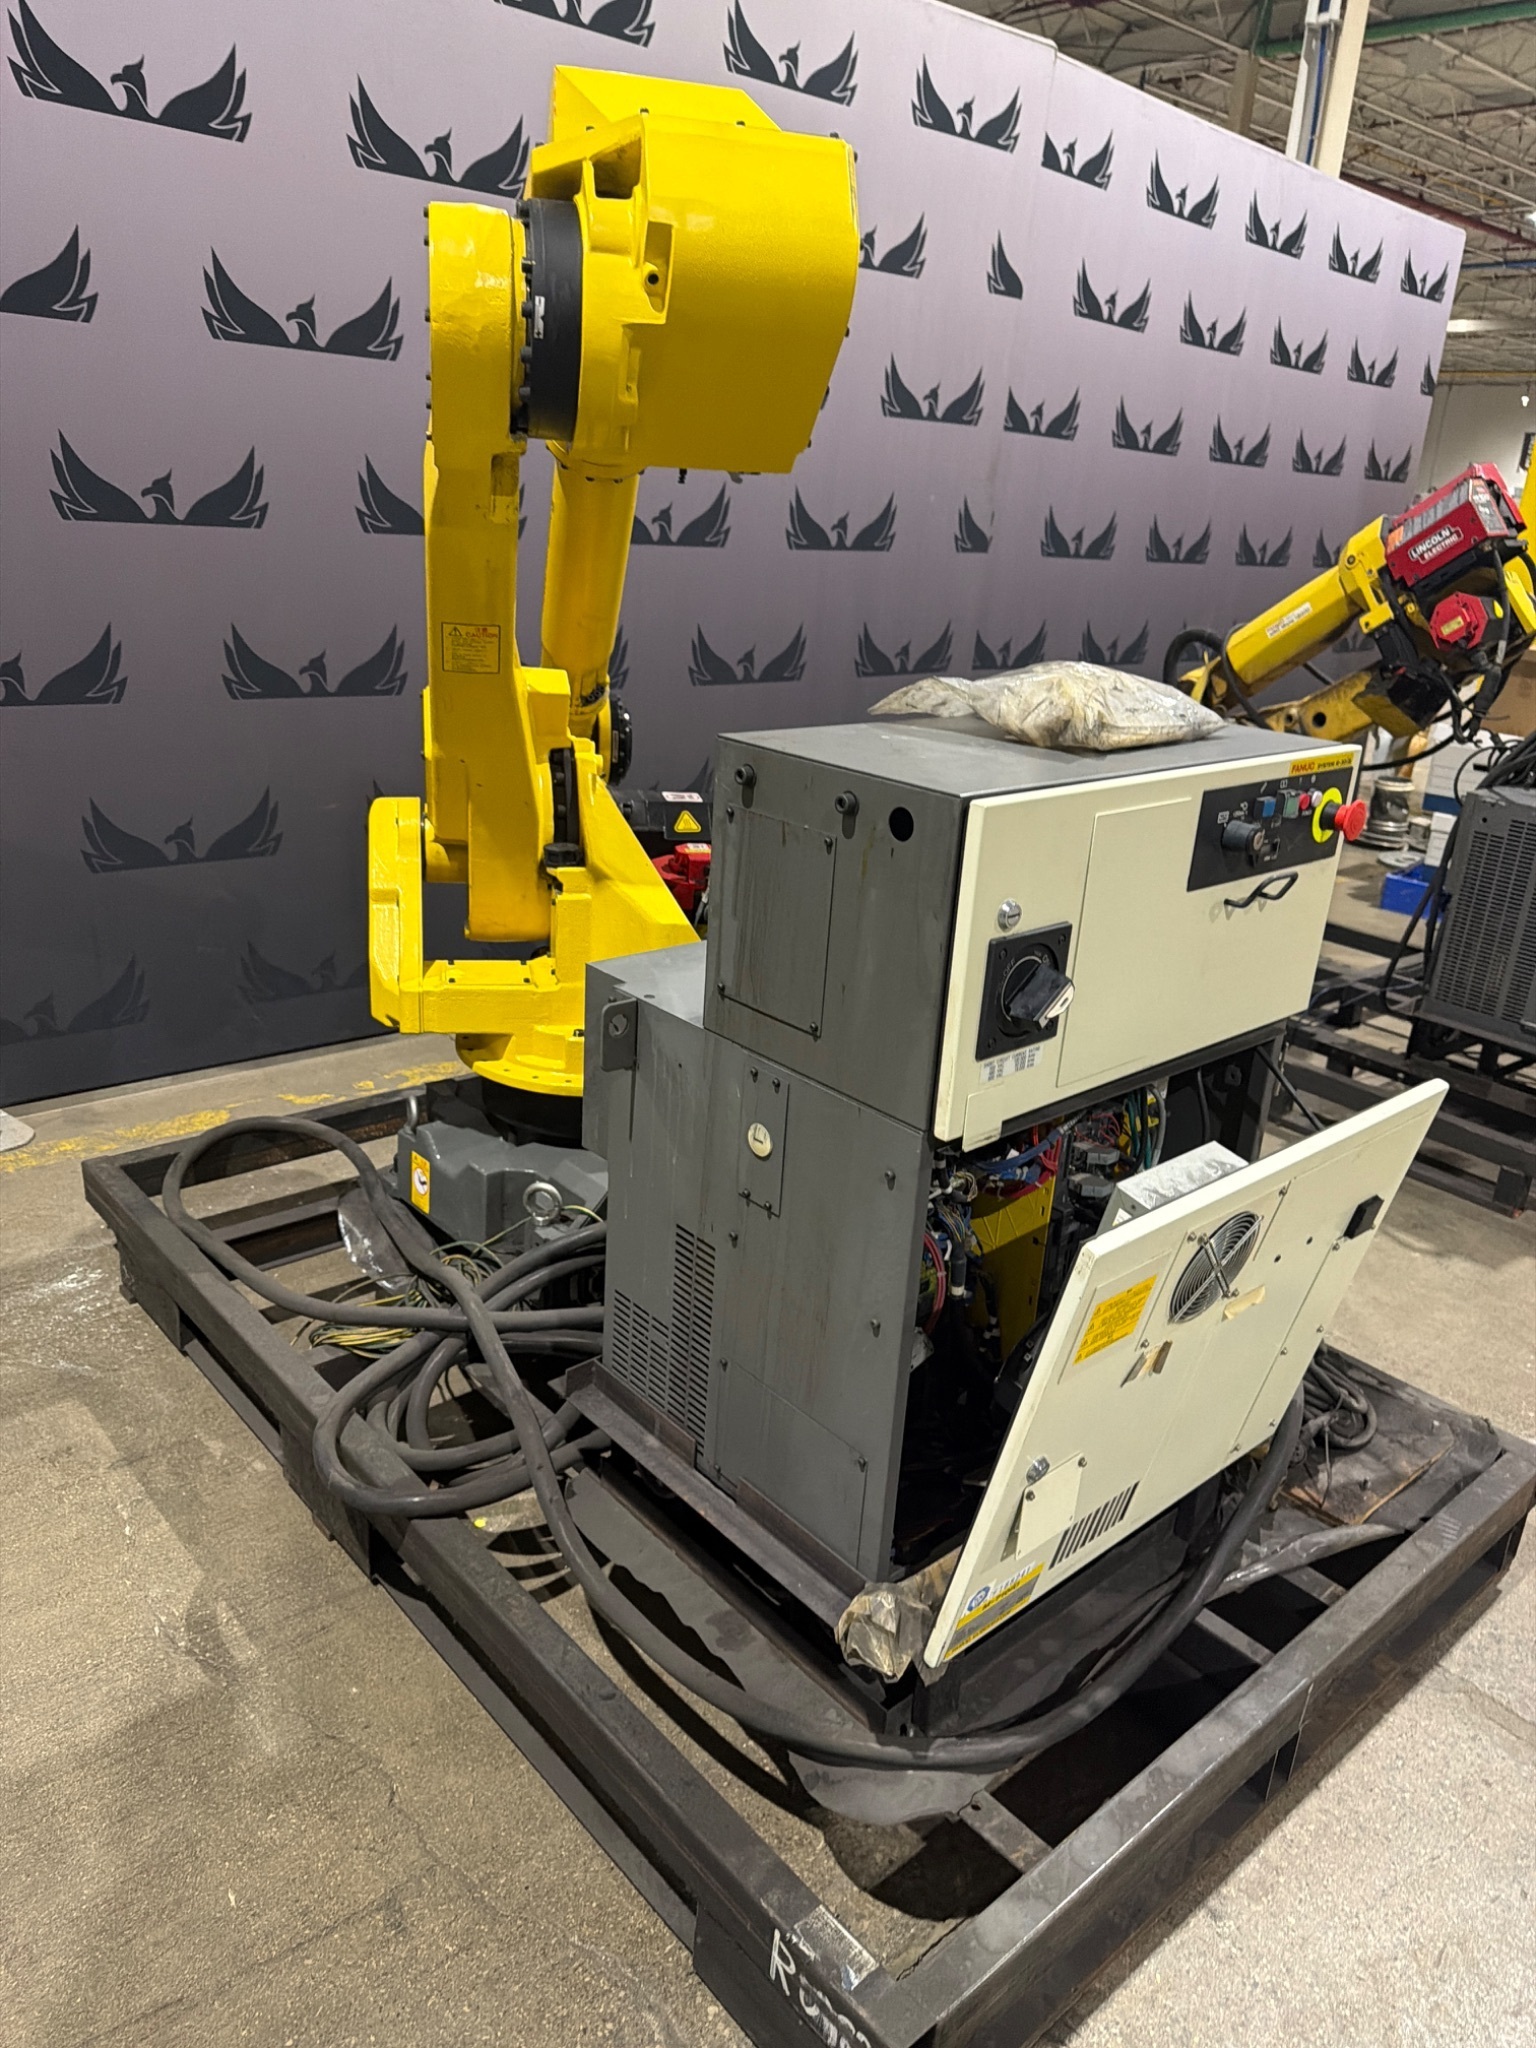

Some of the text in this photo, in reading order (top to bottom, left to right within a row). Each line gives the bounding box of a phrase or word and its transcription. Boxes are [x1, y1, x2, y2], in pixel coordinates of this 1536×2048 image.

[1411, 527, 1451, 559] LINCOLN
[1424, 533, 1459, 560] ELECTRIC
[1291, 762, 1315, 774] FANUC
